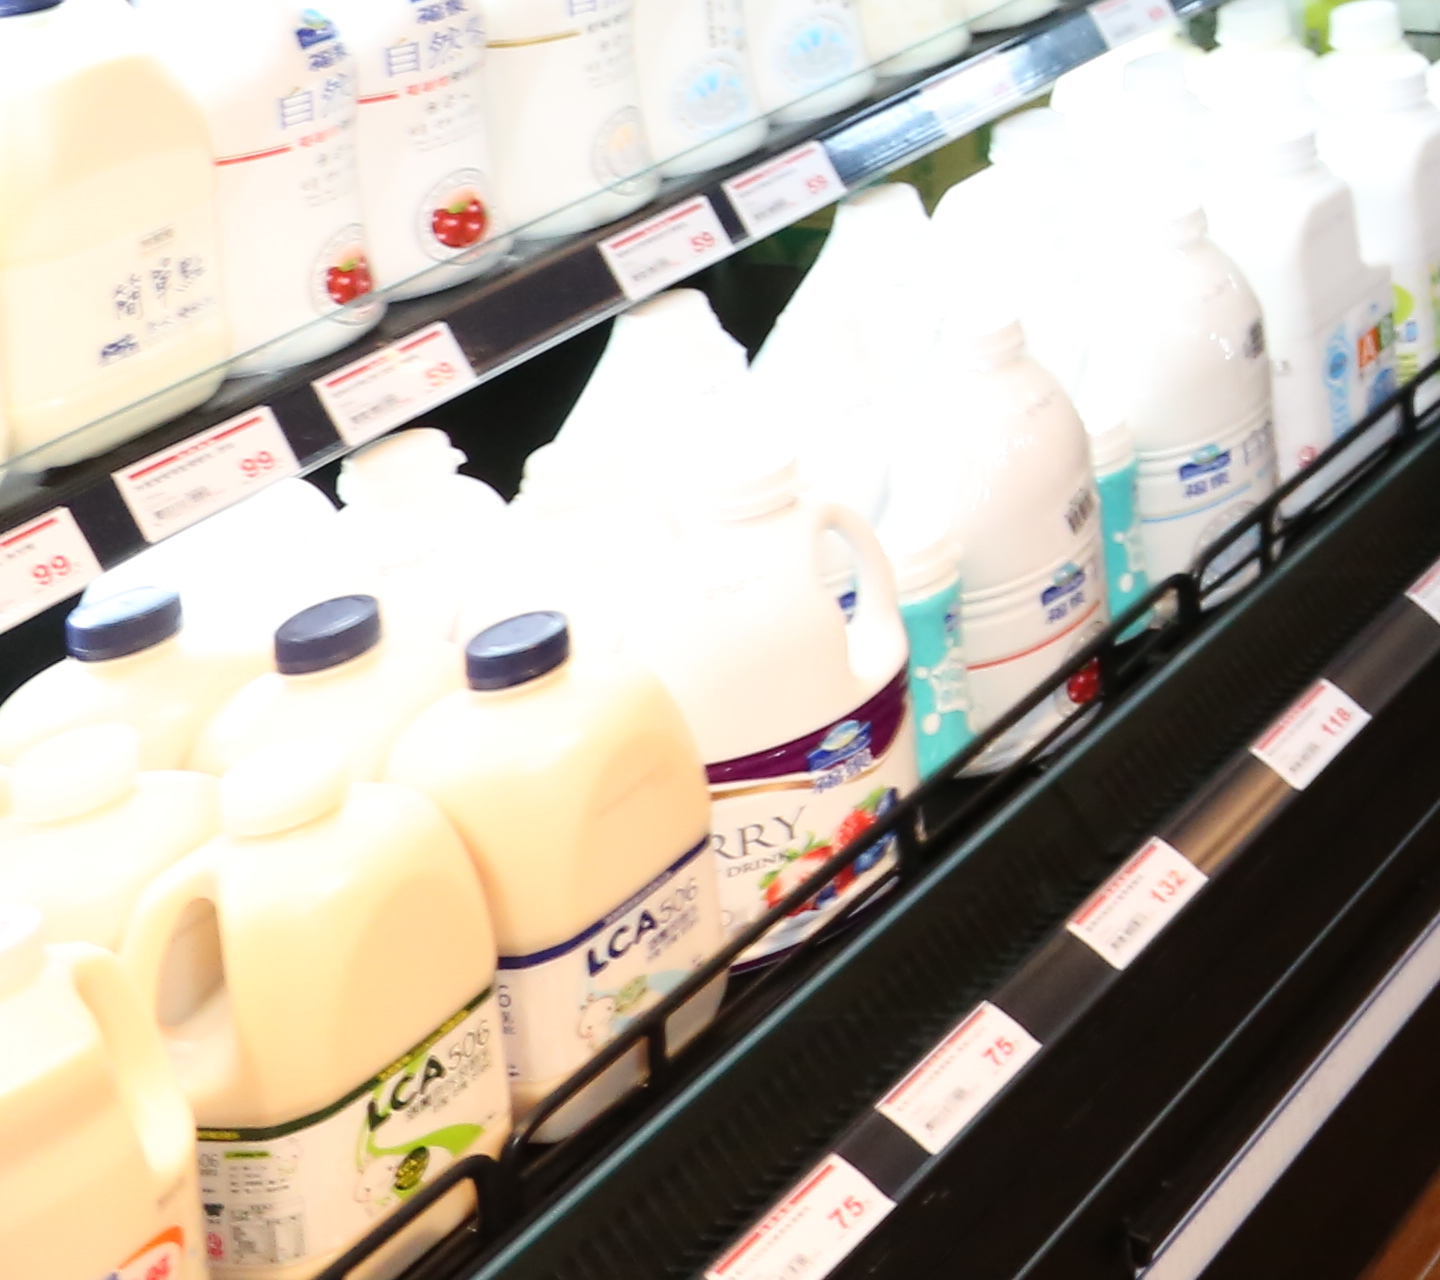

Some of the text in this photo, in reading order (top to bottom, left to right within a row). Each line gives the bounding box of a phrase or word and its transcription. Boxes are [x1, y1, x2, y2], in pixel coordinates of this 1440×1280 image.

[238, 450, 277, 479] 99
[30, 554, 73, 587] 99
[1320, 706, 1353, 738] 118
[1149, 868, 1188, 905] 132
[980, 1035, 1017, 1067] 75
[826, 1194, 867, 1231] 75
